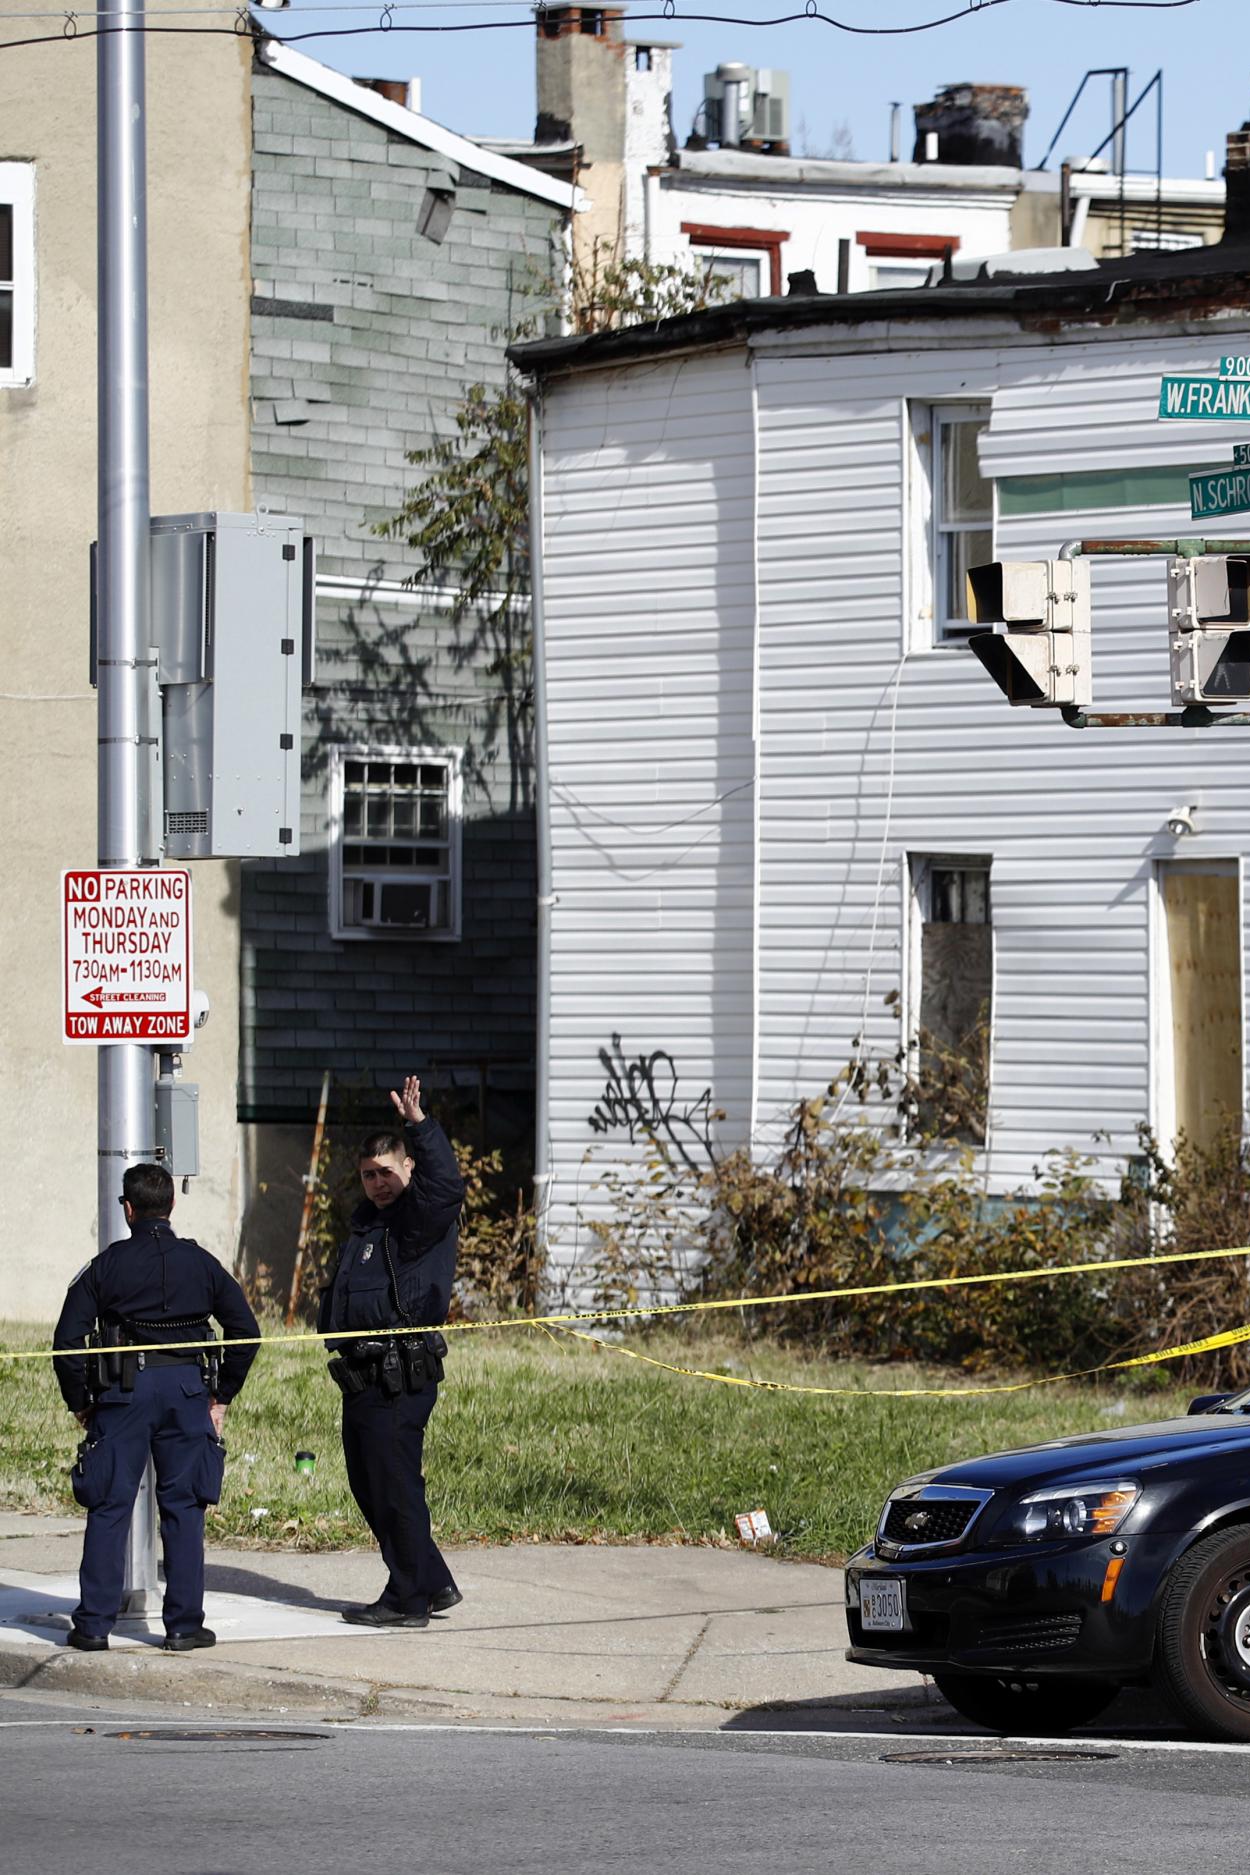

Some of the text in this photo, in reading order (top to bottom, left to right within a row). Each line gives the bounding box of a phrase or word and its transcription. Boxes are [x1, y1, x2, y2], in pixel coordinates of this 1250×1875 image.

[68, 877, 183, 900] NO PARKING
[74, 906, 179, 928] MONDAY AND
[82, 931, 172, 954] THURSDAY
[90, 992, 166, 1001] STREET CLEANING
[70, 1016, 186, 1034] TOW AWAY ZONE
[877, 1593, 899, 1617] 3050
